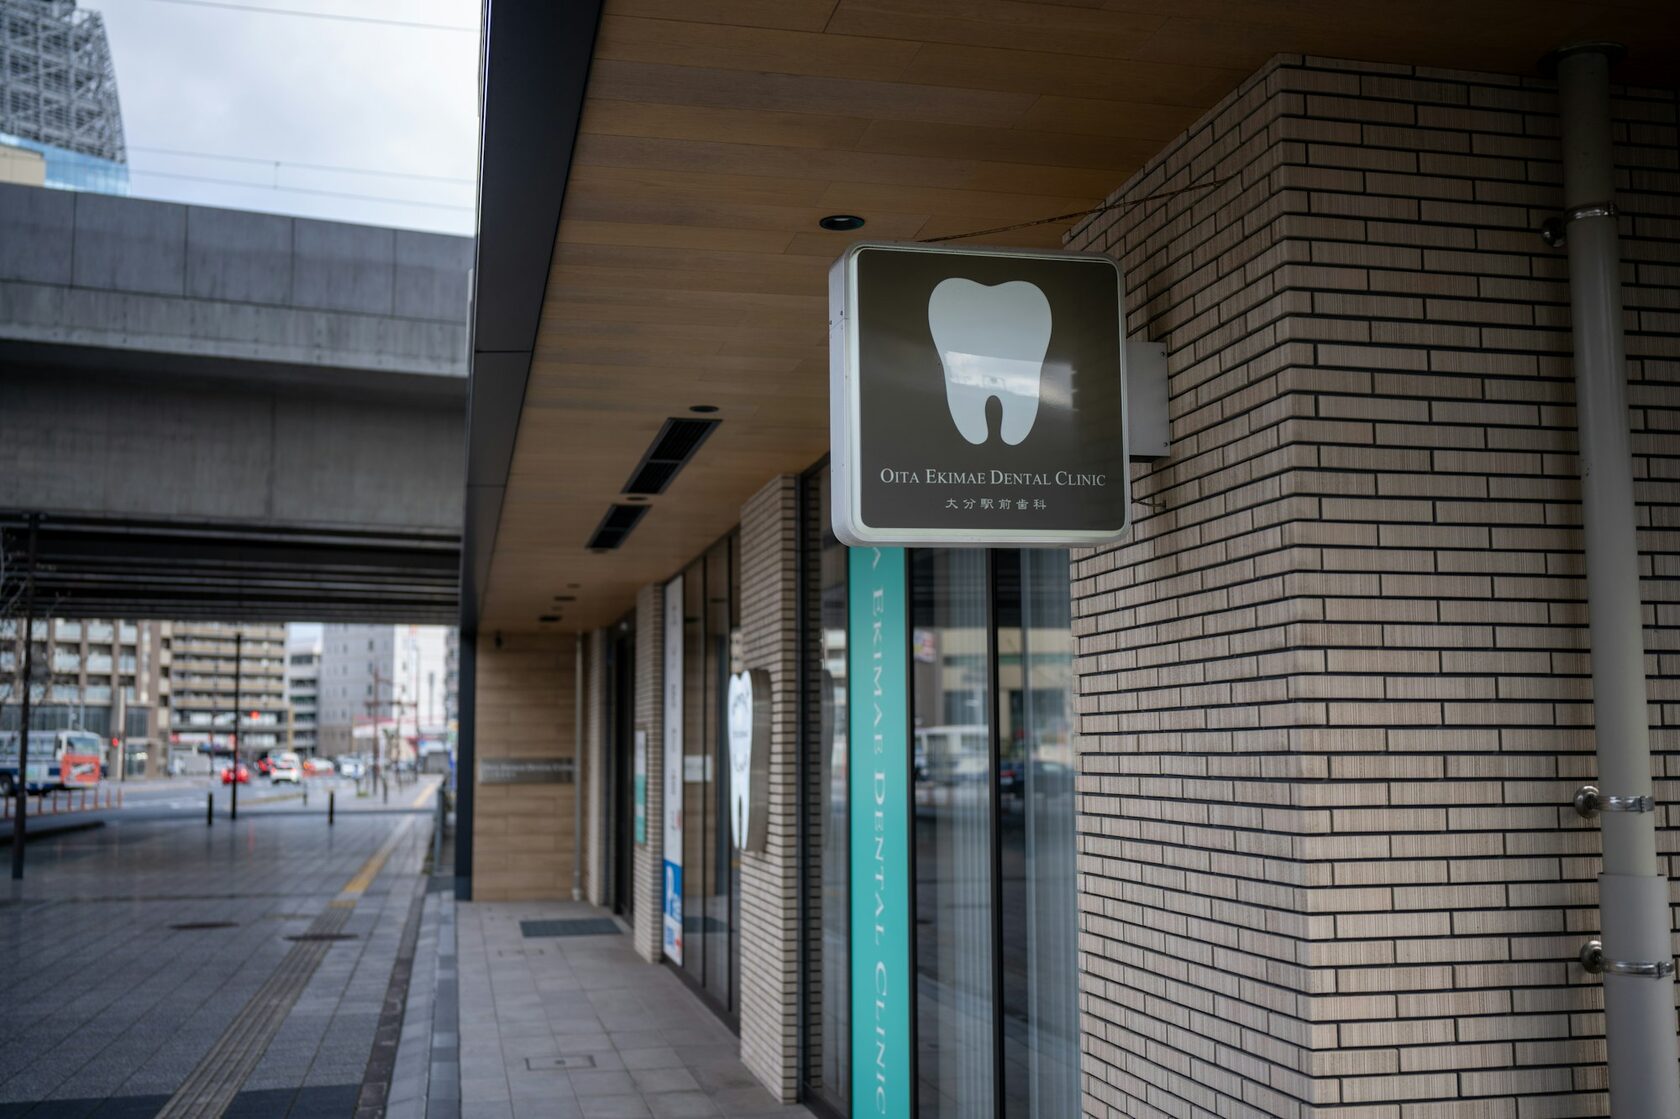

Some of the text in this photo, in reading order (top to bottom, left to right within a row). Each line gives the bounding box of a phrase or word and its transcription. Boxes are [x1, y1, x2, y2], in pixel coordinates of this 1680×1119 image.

[880, 468, 1106, 486] OITA EKIMAE DENTAL CLINIC
[945, 498, 1047, 510] 大分駅前歯科
[874, 771, 886, 946] DENTAL
[875, 960, 887, 1115] CLINIC
